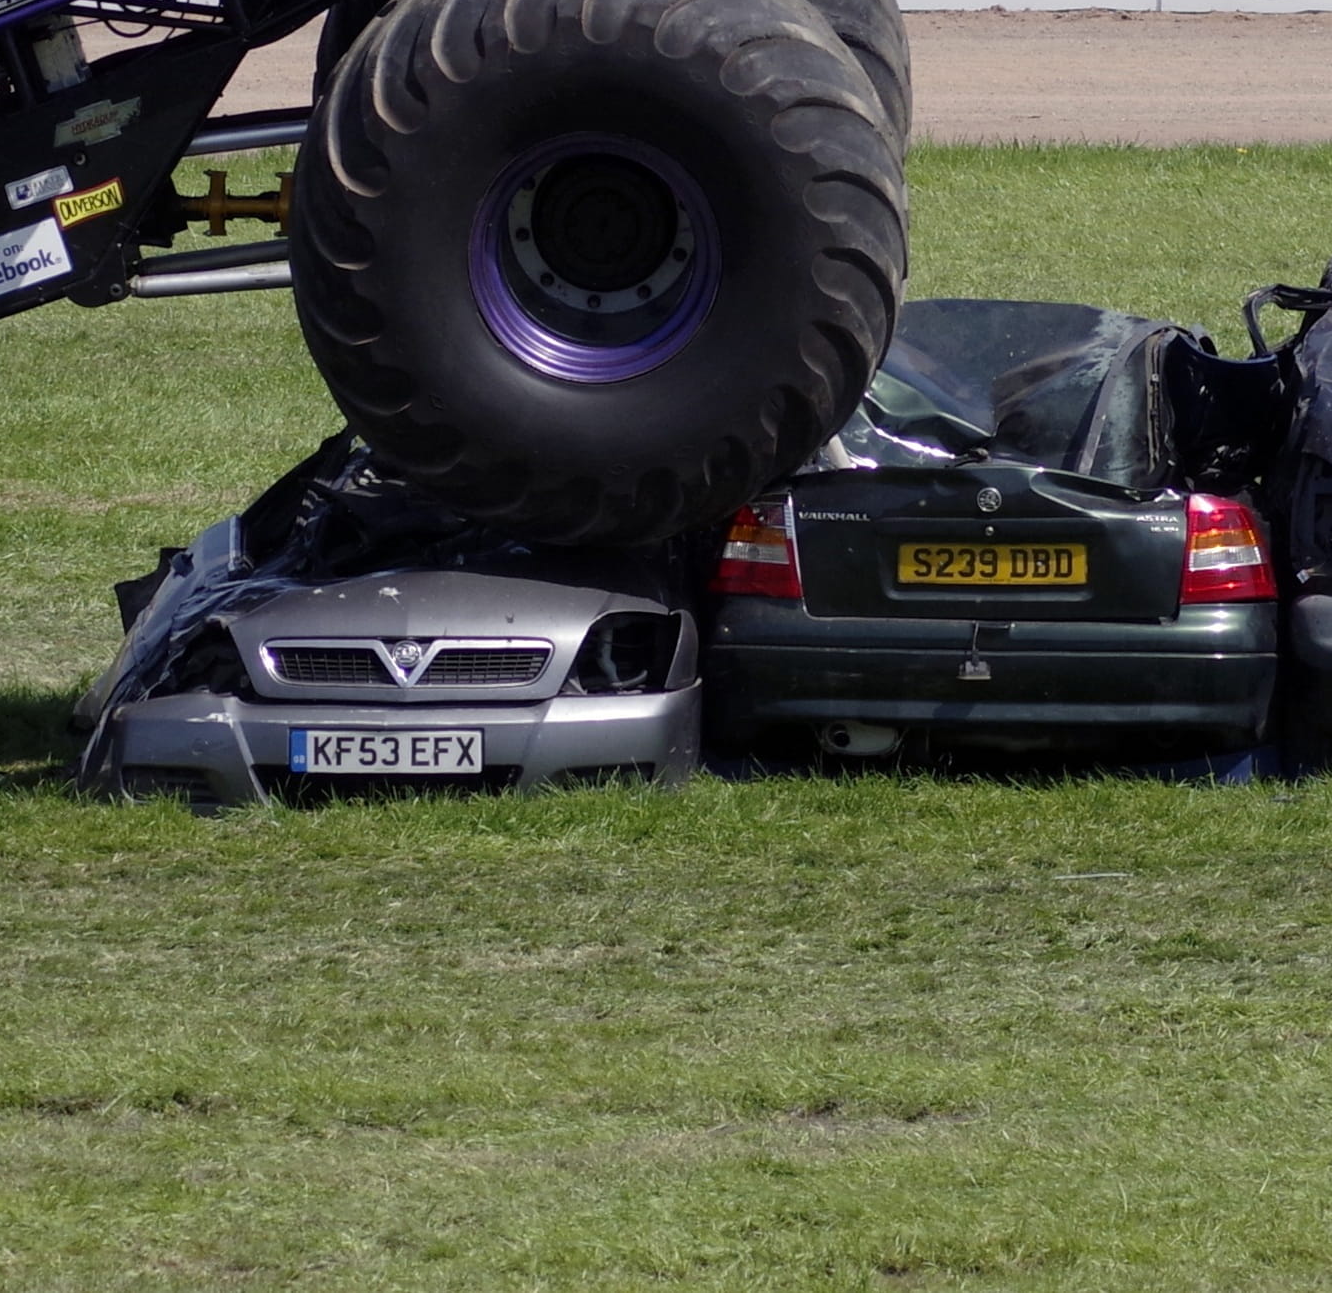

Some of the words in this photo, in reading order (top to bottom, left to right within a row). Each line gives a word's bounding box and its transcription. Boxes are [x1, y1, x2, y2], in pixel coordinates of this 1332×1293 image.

[798, 510, 871, 522] VAUXHALL
[1135, 514, 1179, 524] ASTRA
[913, 547, 1000, 580] S239
[1009, 548, 1074, 579] DBD
[311, 736, 400, 768] KF53
[410, 736, 475, 767] EFX
